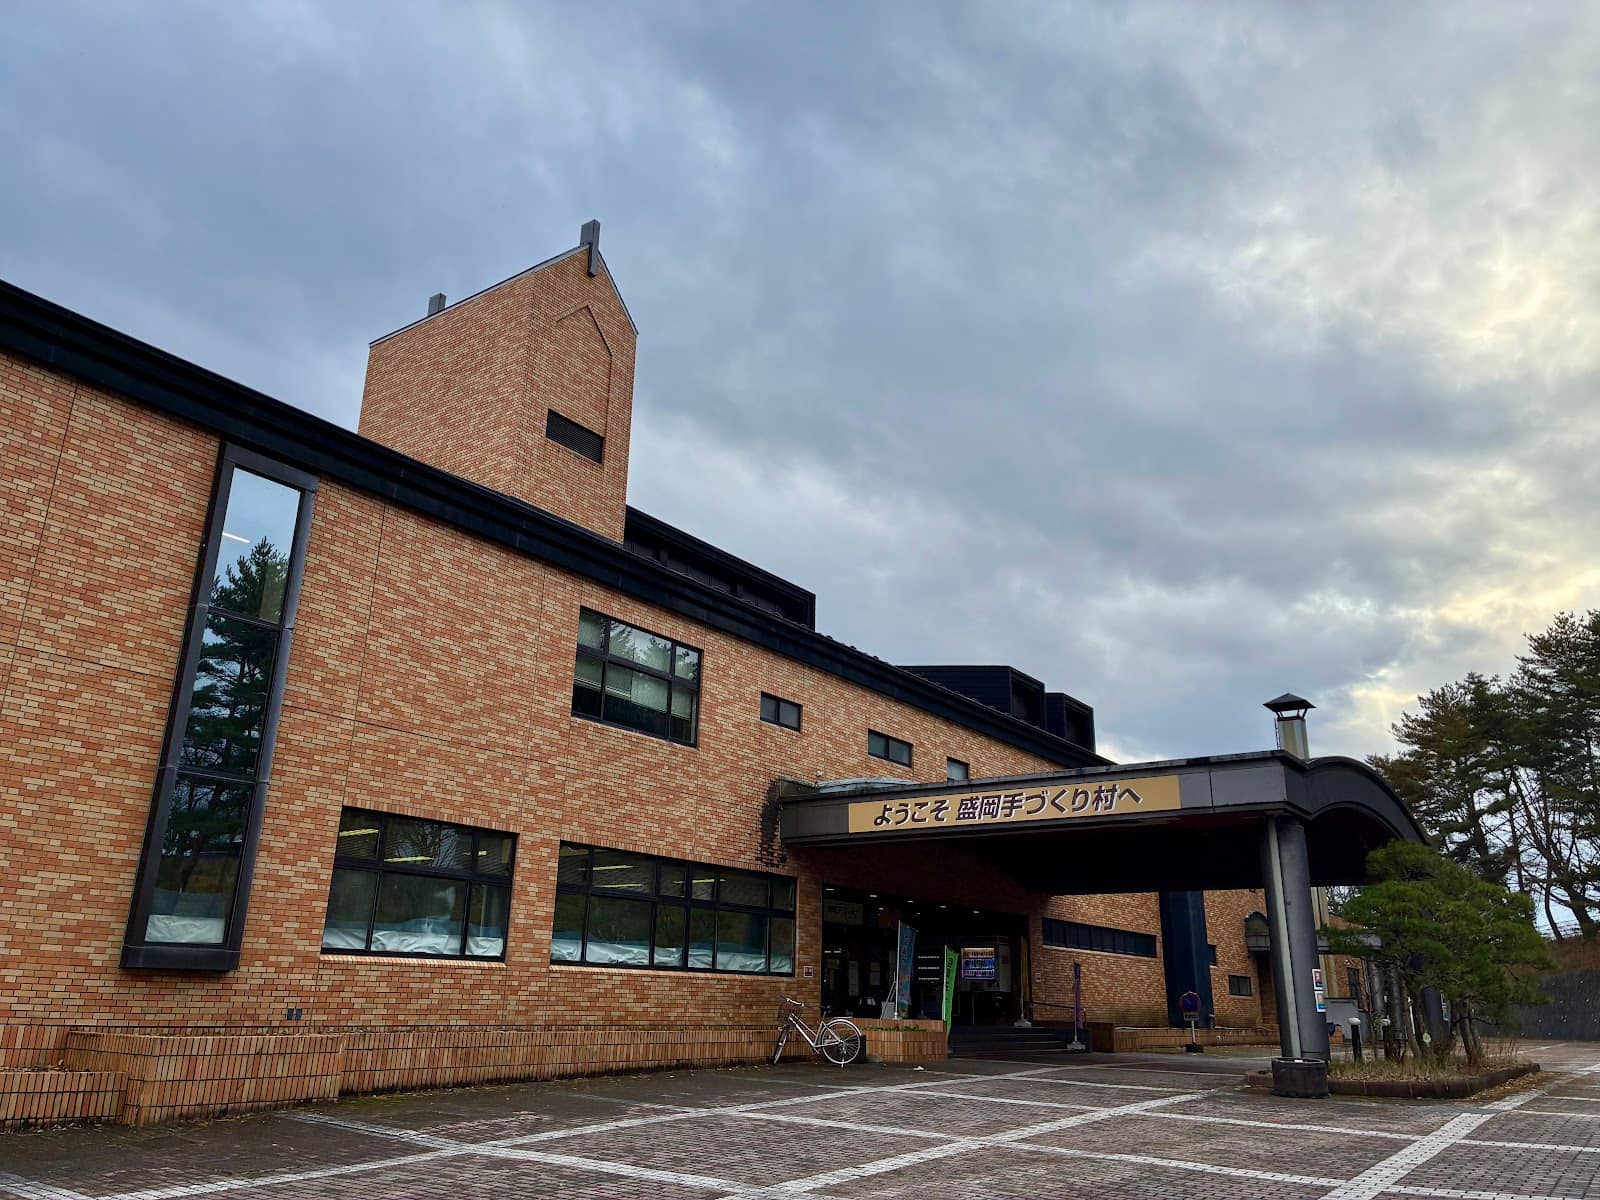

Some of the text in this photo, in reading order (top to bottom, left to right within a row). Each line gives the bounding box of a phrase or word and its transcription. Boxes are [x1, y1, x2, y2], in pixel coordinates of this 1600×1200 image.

[873, 784, 1143, 825] ようこそ 盛岡手づくり村へ
